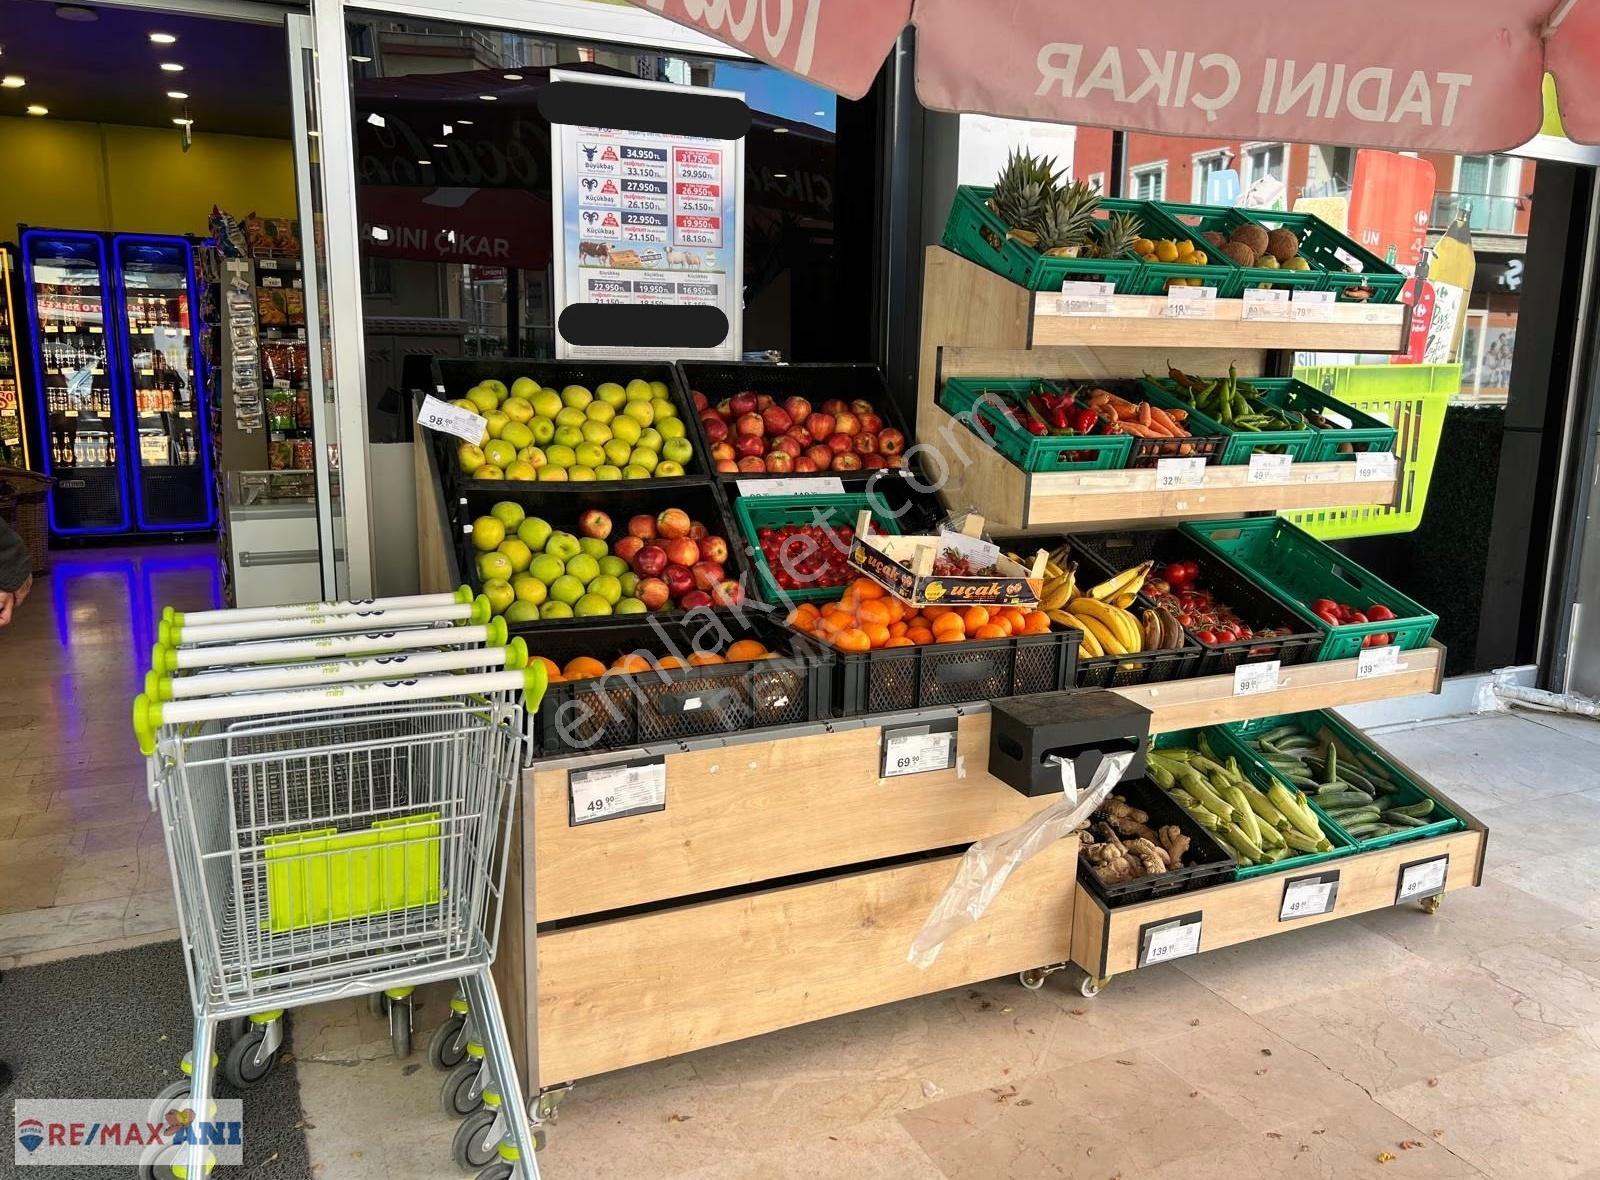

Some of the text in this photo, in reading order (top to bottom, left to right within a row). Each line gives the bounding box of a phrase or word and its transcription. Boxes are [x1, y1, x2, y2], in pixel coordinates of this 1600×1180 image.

[429, 414, 443, 426] 98
[1163, 477, 1173, 486] 32
[868, 555, 901, 581] uçak
[950, 582, 1003, 599] uçak
[326, 689, 344, 697] mini
[897, 757, 910, 768] 69
[587, 799, 603, 811] 49
[1152, 946, 1167, 957] 139
